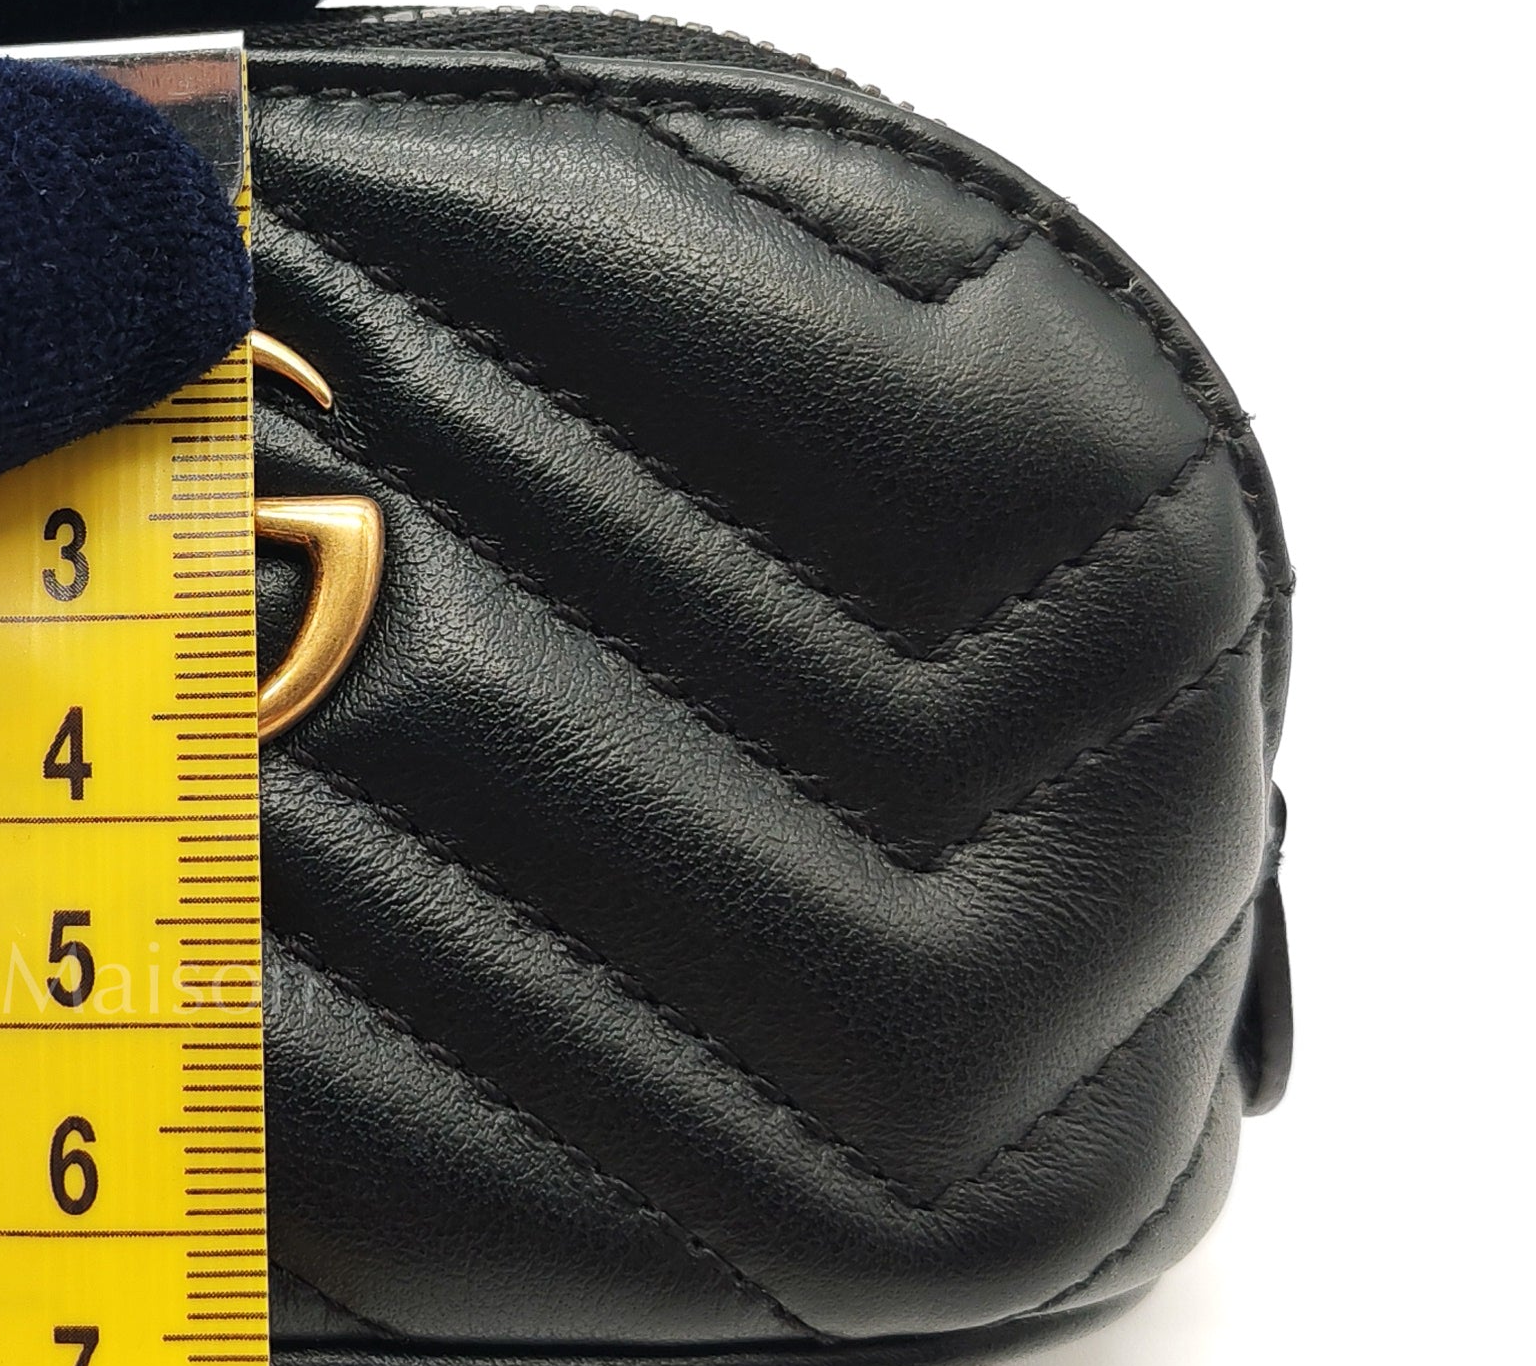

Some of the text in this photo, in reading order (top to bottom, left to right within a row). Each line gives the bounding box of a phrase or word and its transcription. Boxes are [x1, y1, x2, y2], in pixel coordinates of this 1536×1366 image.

[41, 507, 91, 602] 3
[42, 706, 93, 802] 4
[46, 909, 96, 1009] 5
[49, 1115, 100, 1217] 6
